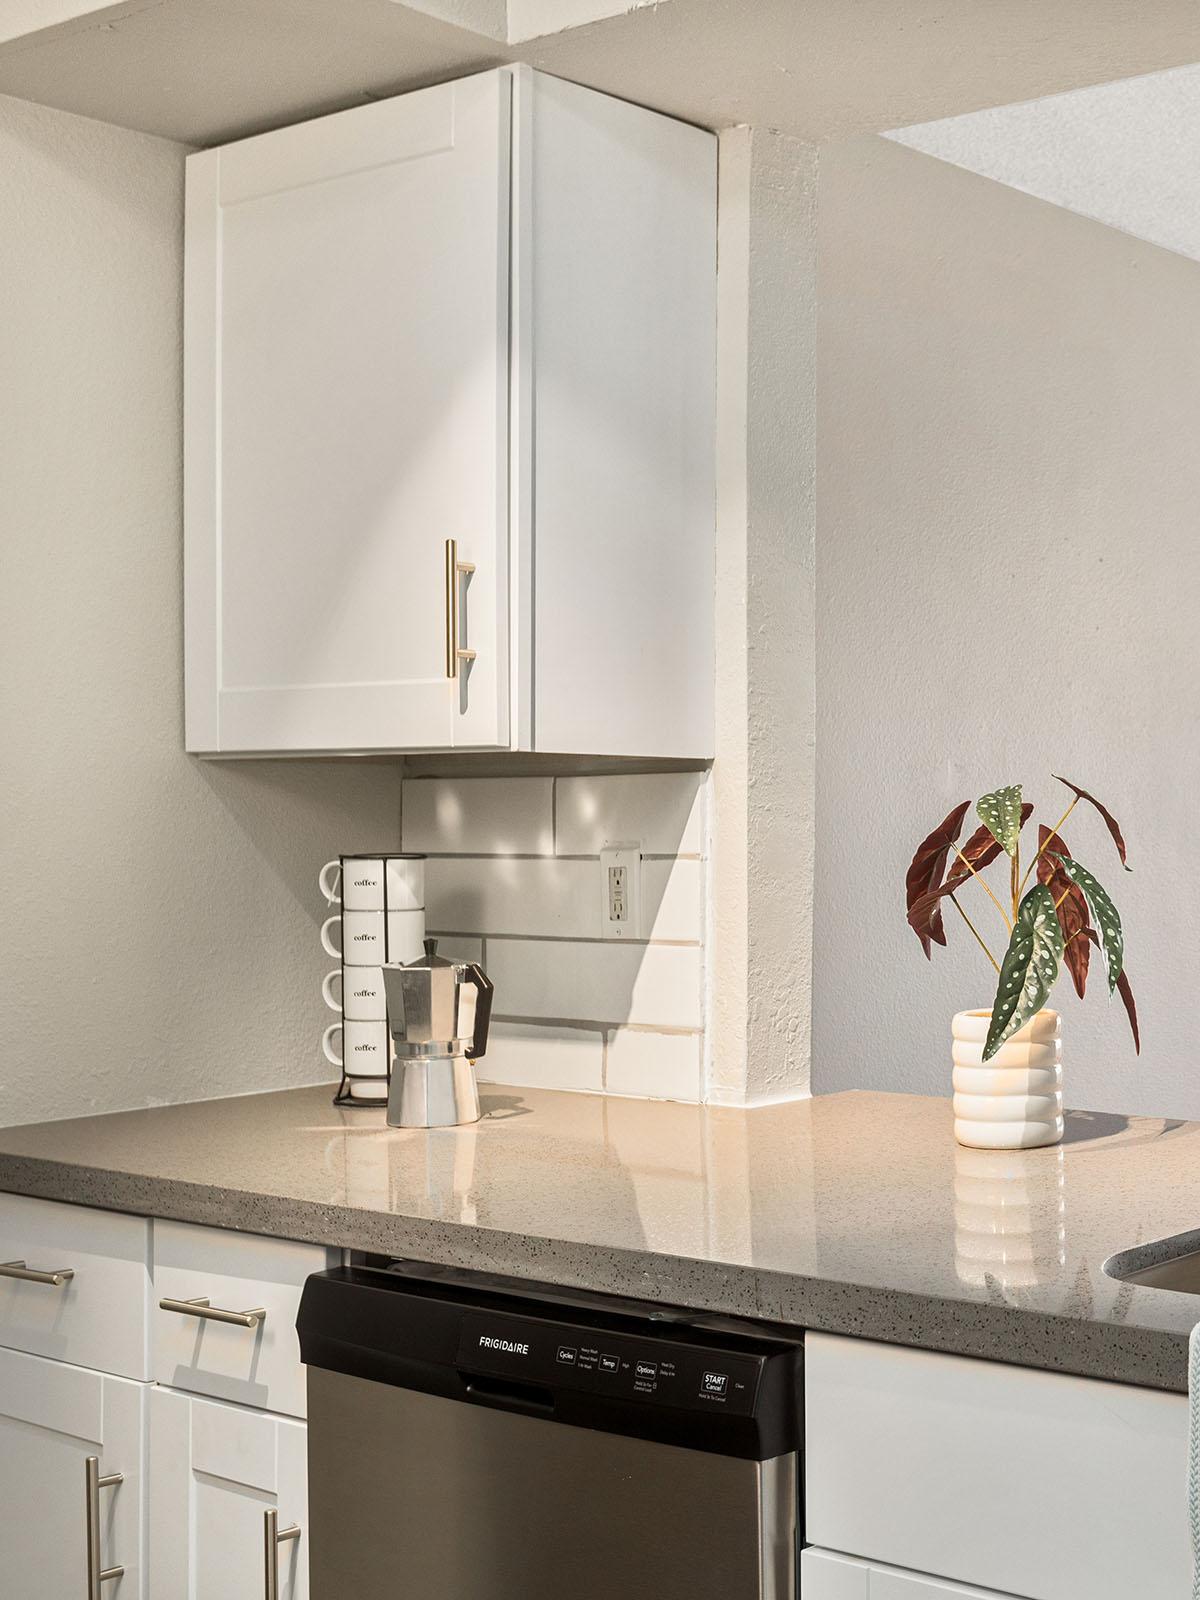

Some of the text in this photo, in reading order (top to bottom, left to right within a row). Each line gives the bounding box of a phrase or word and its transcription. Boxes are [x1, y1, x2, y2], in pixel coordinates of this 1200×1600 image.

[353, 879, 378, 887] coffee
[353, 933, 377, 941] coffee
[353, 989, 377, 997] coffee
[354, 1043, 377, 1052] coffee
[479, 1336, 529, 1355] FRIGIDAIRE
[559, 1350, 574, 1360] Cycles
[602, 1358, 616, 1369] Temp
[637, 1365, 655, 1375] Options
[705, 1374, 726, 1385] START
[706, 1382, 722, 1391] Cancel
